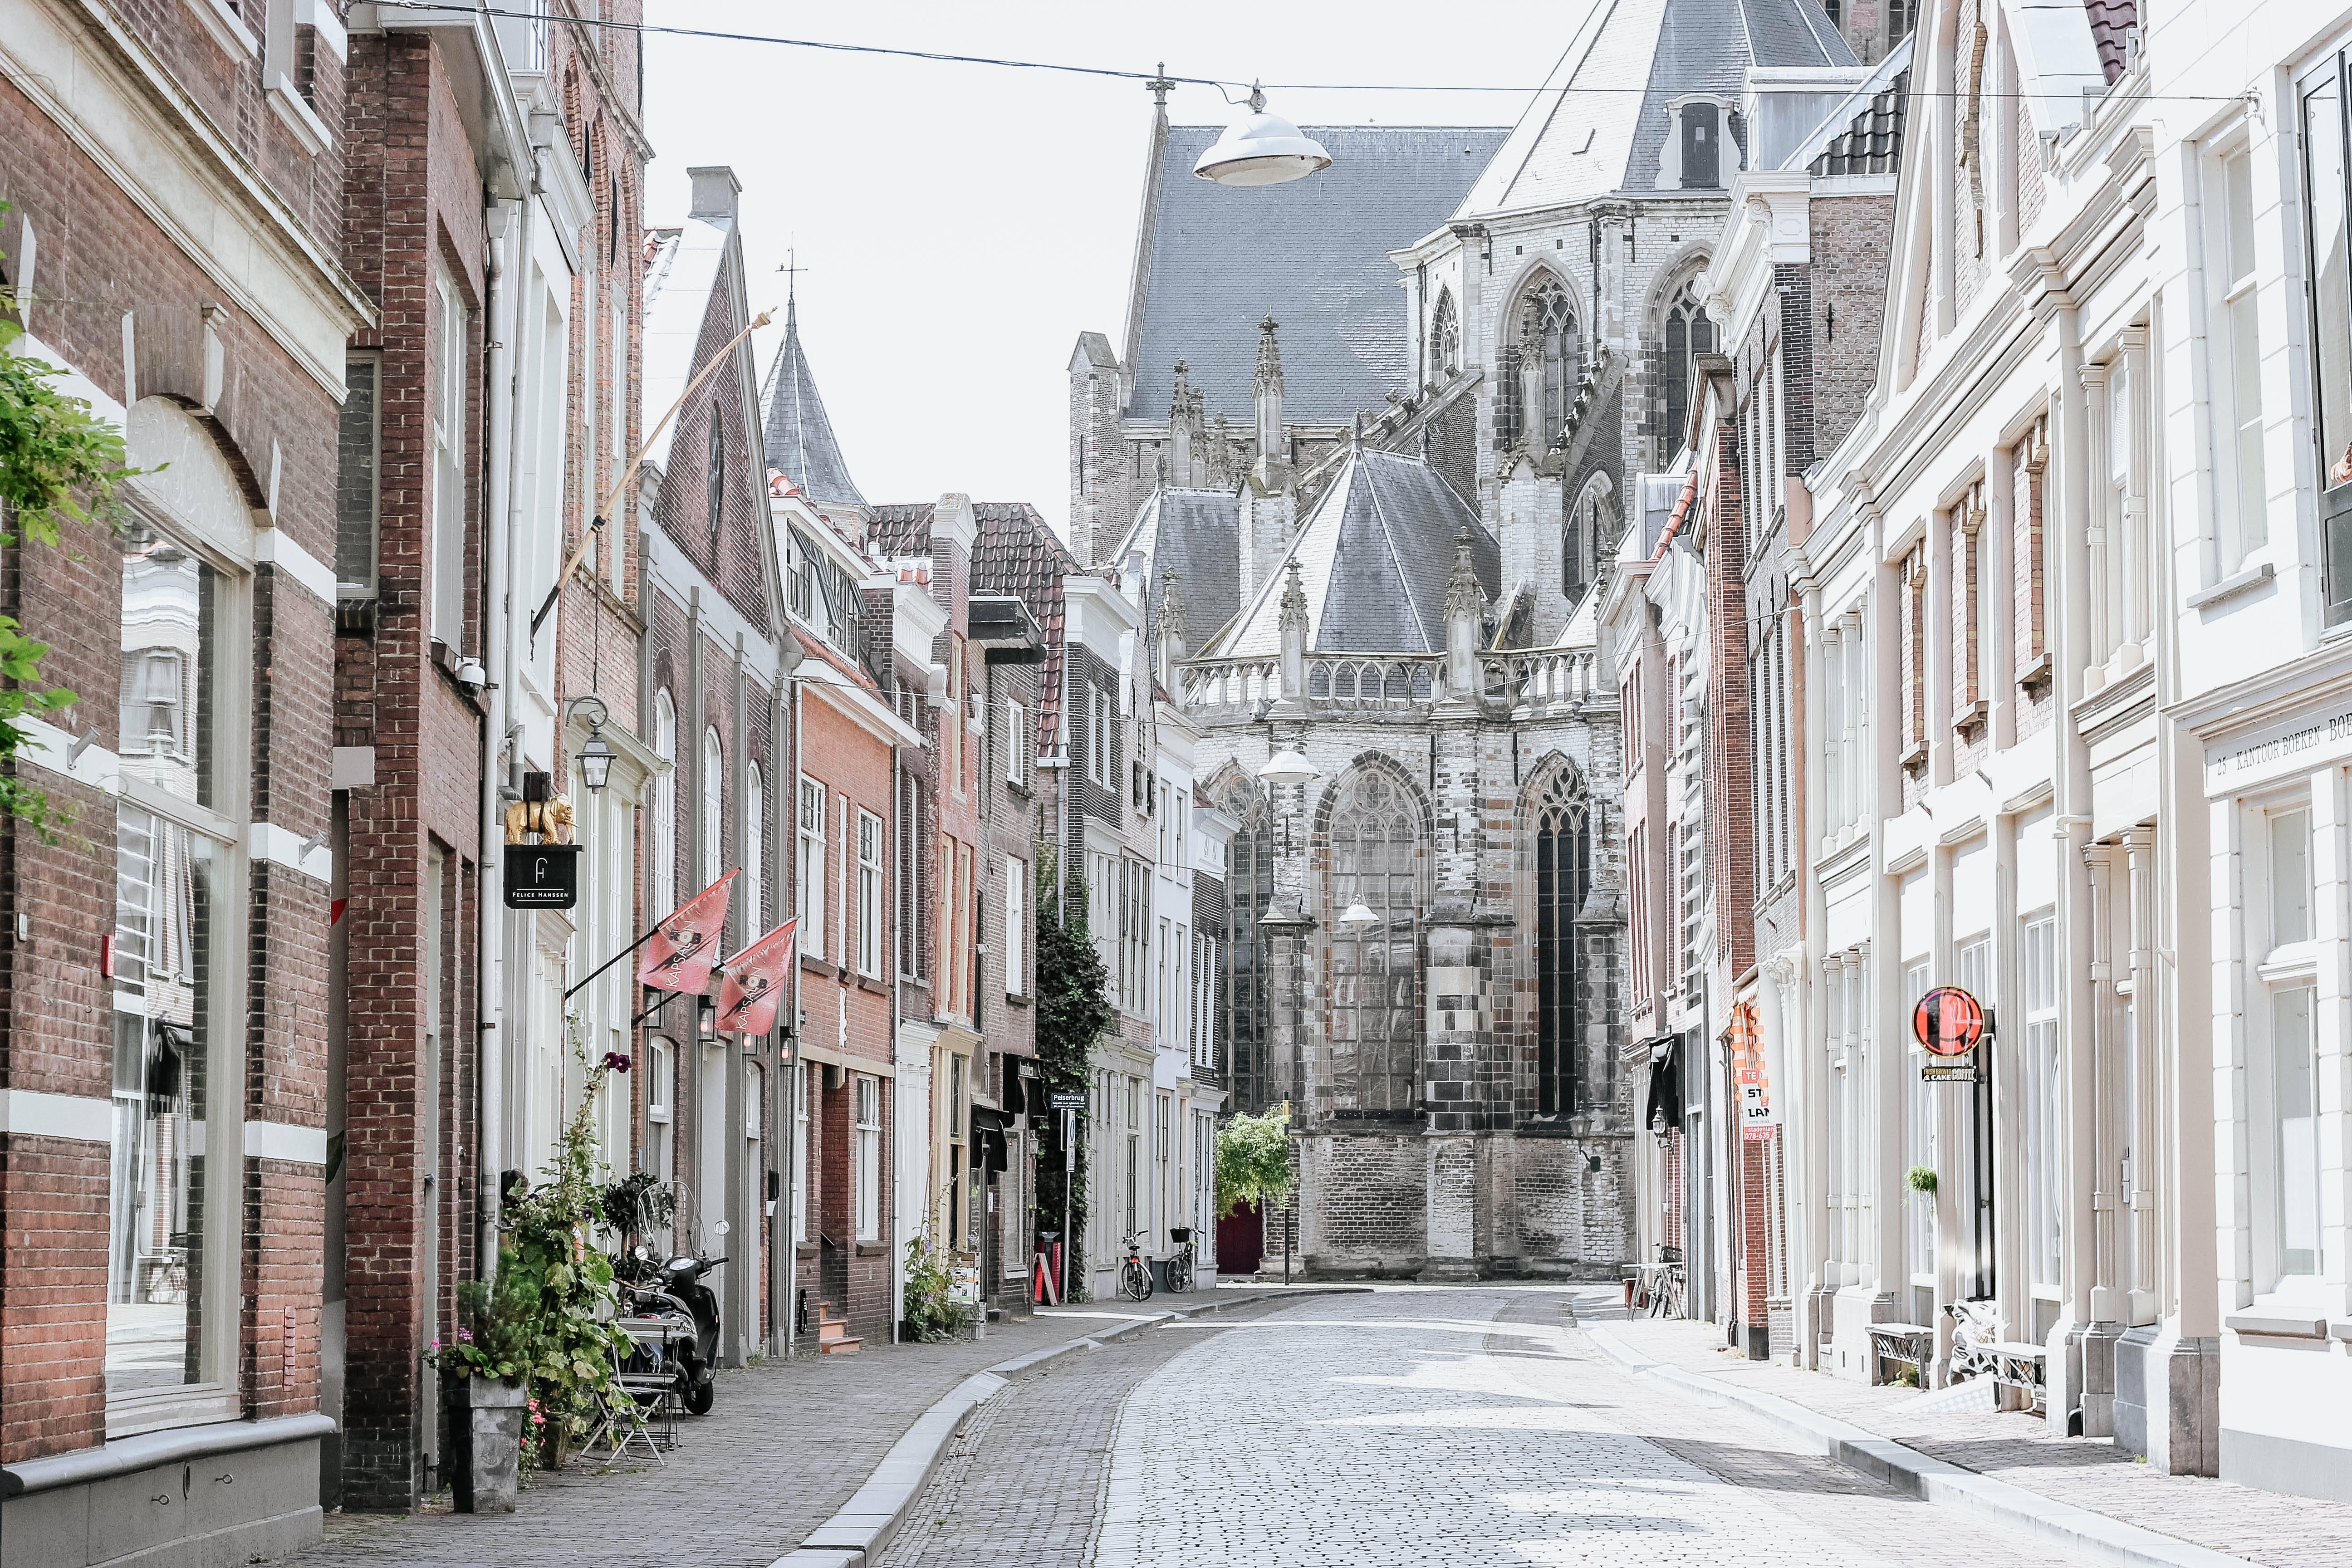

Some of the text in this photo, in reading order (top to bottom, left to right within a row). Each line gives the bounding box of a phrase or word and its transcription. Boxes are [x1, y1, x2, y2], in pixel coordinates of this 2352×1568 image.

[2217, 756, 2227, 775] 25
[2236, 740, 2279, 770] KANTOOR
[2283, 725, 2321, 756] BOEKEN
[1745, 1072, 1757, 1080] TE
[1951, 1068, 1975, 1080] COFFEE
